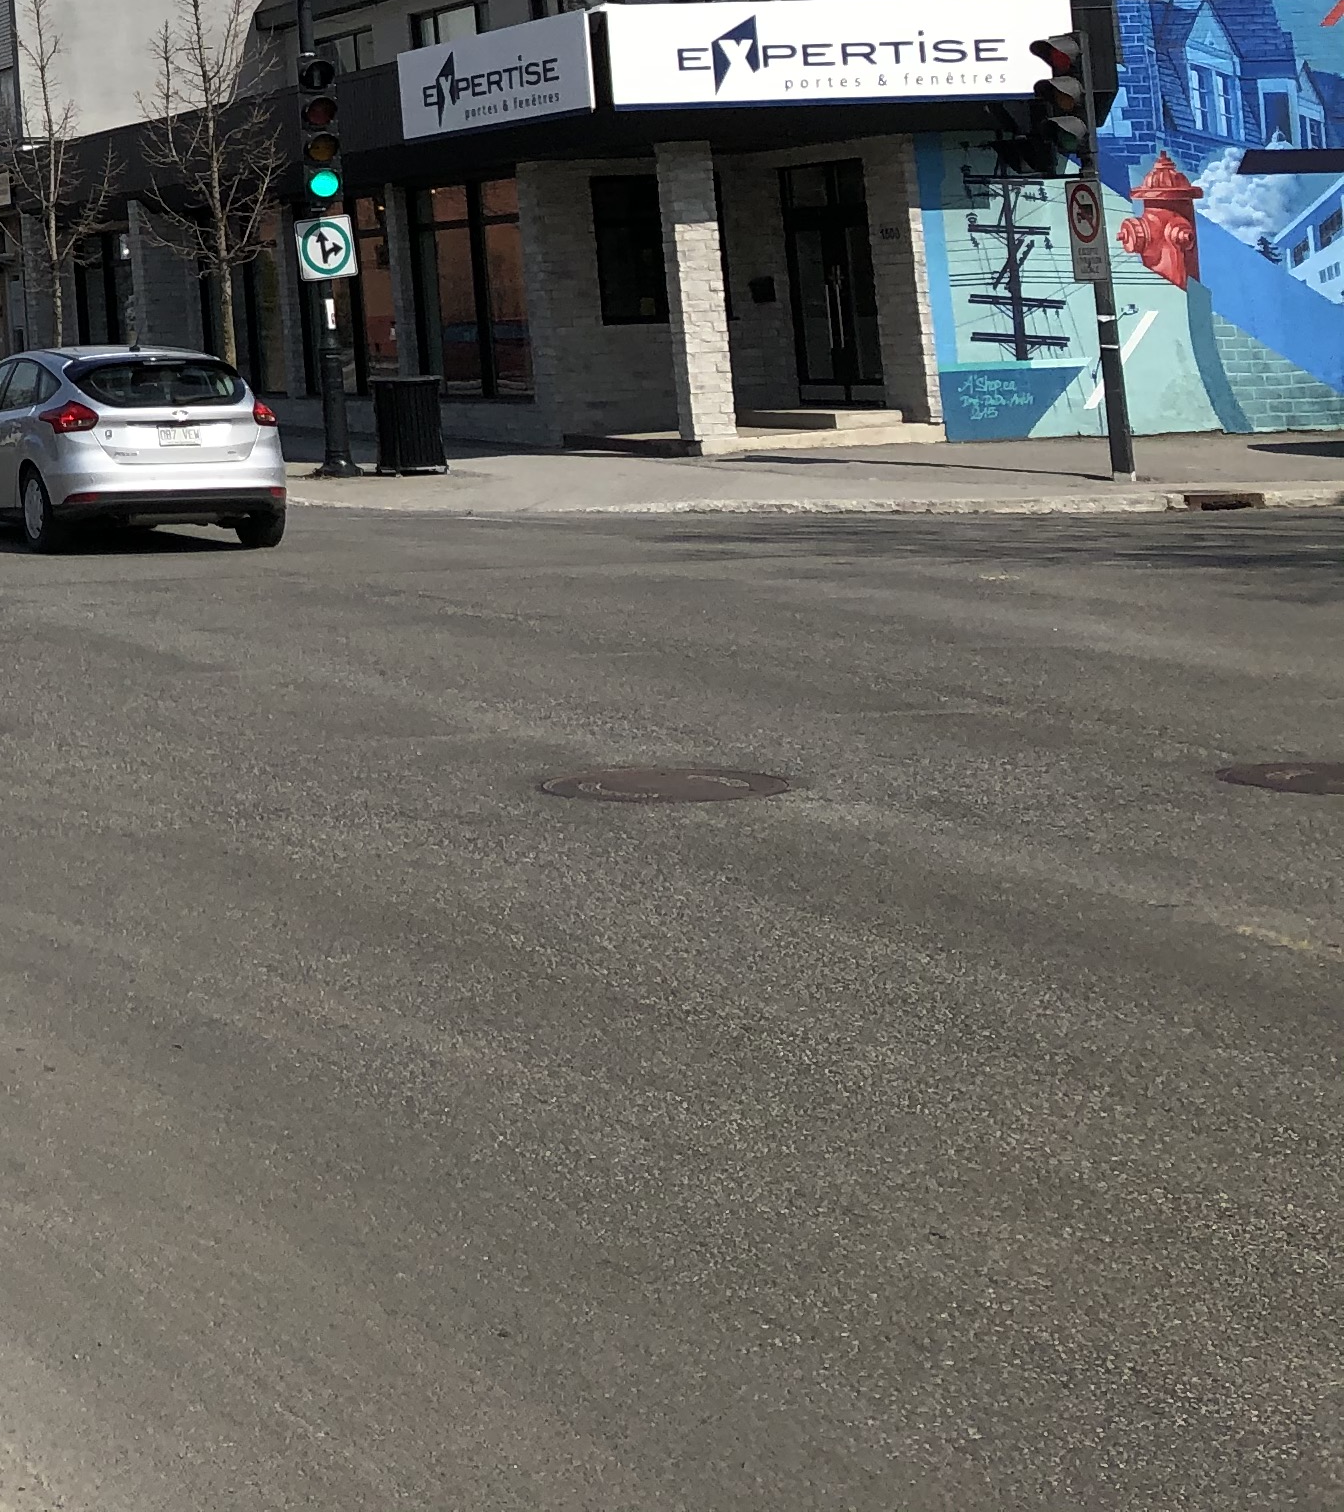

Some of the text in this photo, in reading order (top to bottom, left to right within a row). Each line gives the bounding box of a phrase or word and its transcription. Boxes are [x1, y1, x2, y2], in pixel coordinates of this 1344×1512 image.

[784, 71, 1008, 92] portes & fenêtres
[465, 91, 561, 121] portes & fenêtres
